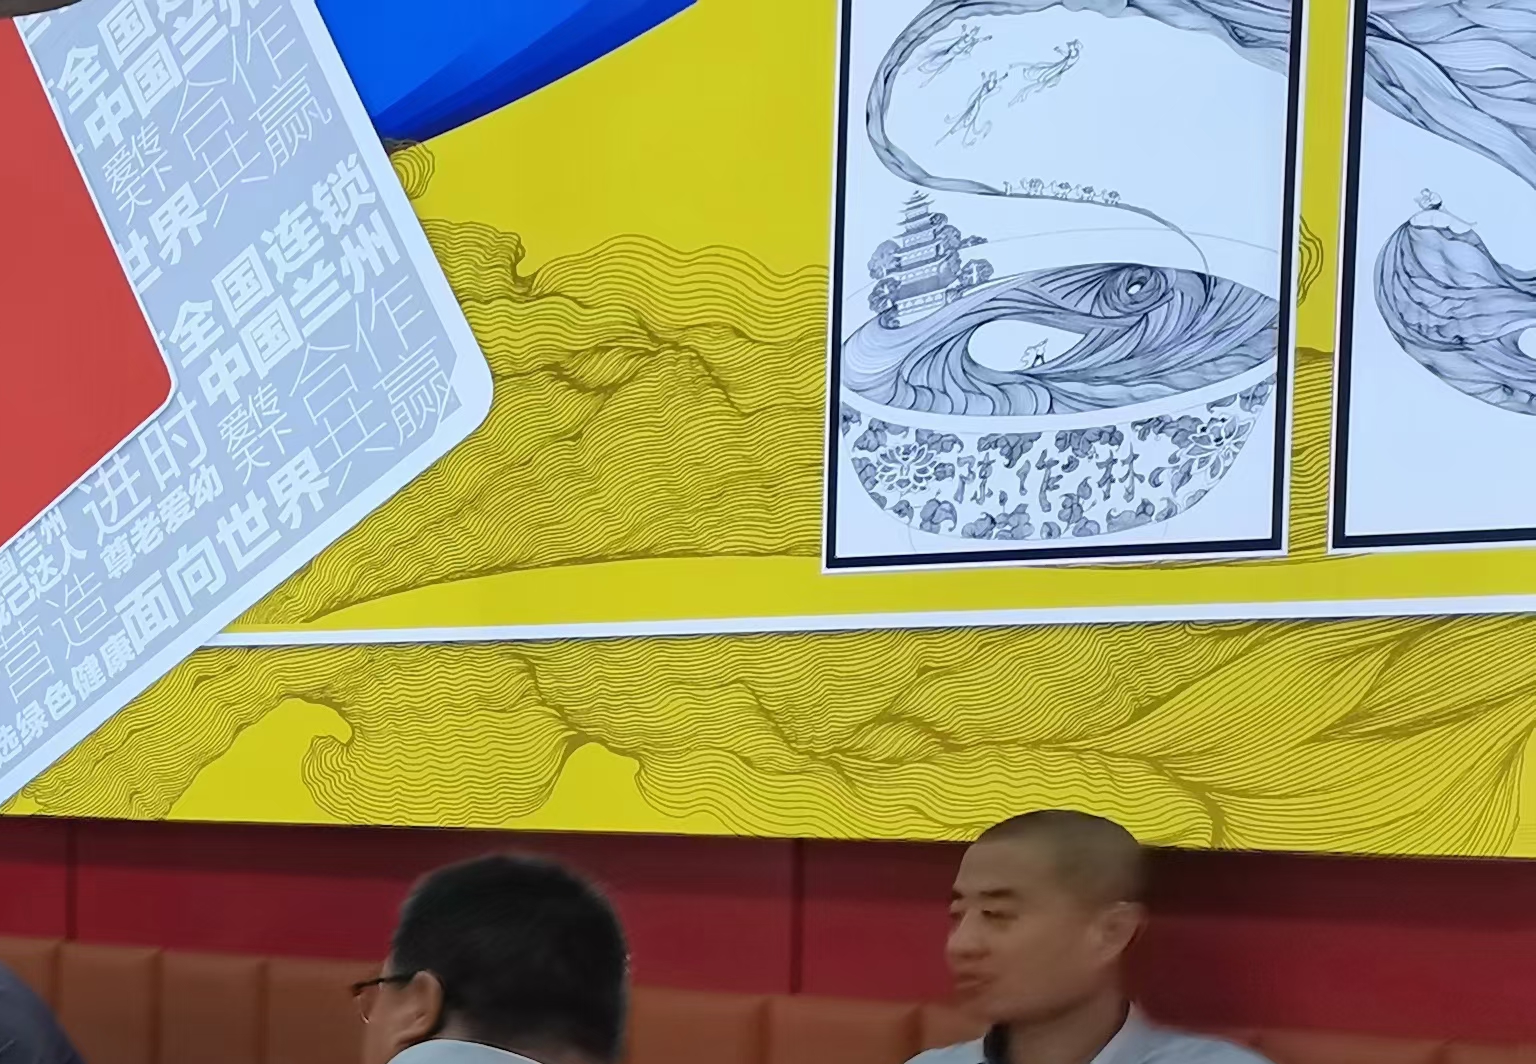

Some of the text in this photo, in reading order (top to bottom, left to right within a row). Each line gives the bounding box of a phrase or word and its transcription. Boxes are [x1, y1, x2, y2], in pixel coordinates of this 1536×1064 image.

[168, 153, 376, 368] 全国连锁
[198, 209, 401, 407] 中国兰州
[100, 462, 225, 579] 尊老爱幼
[115, 446, 330, 655] 面向世界
